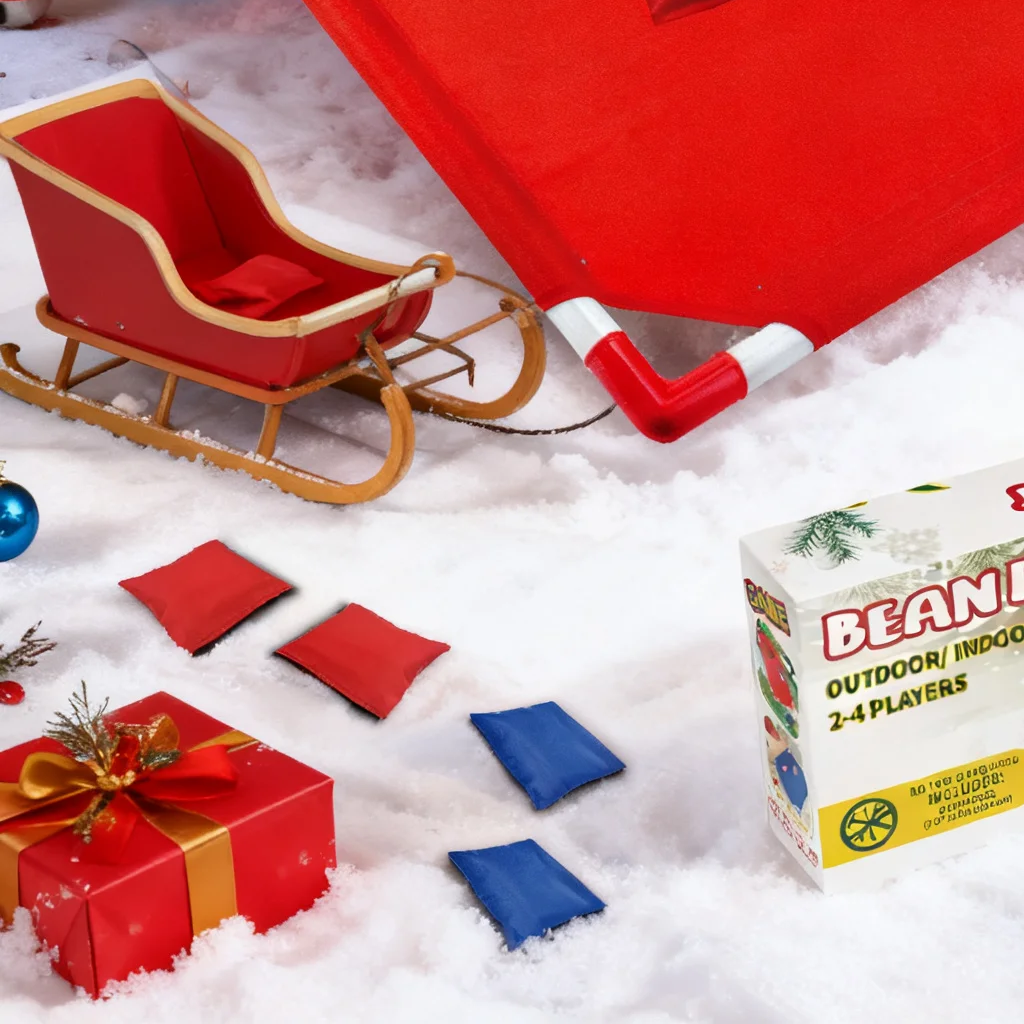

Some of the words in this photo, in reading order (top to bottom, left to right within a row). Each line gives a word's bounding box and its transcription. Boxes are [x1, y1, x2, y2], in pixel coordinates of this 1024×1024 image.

[822, 568, 1001, 661] BEAN
[825, 646, 947, 699] OUTDOOR/
[828, 703, 866, 731] 2-4
[869, 673, 968, 719] PLAYERS
